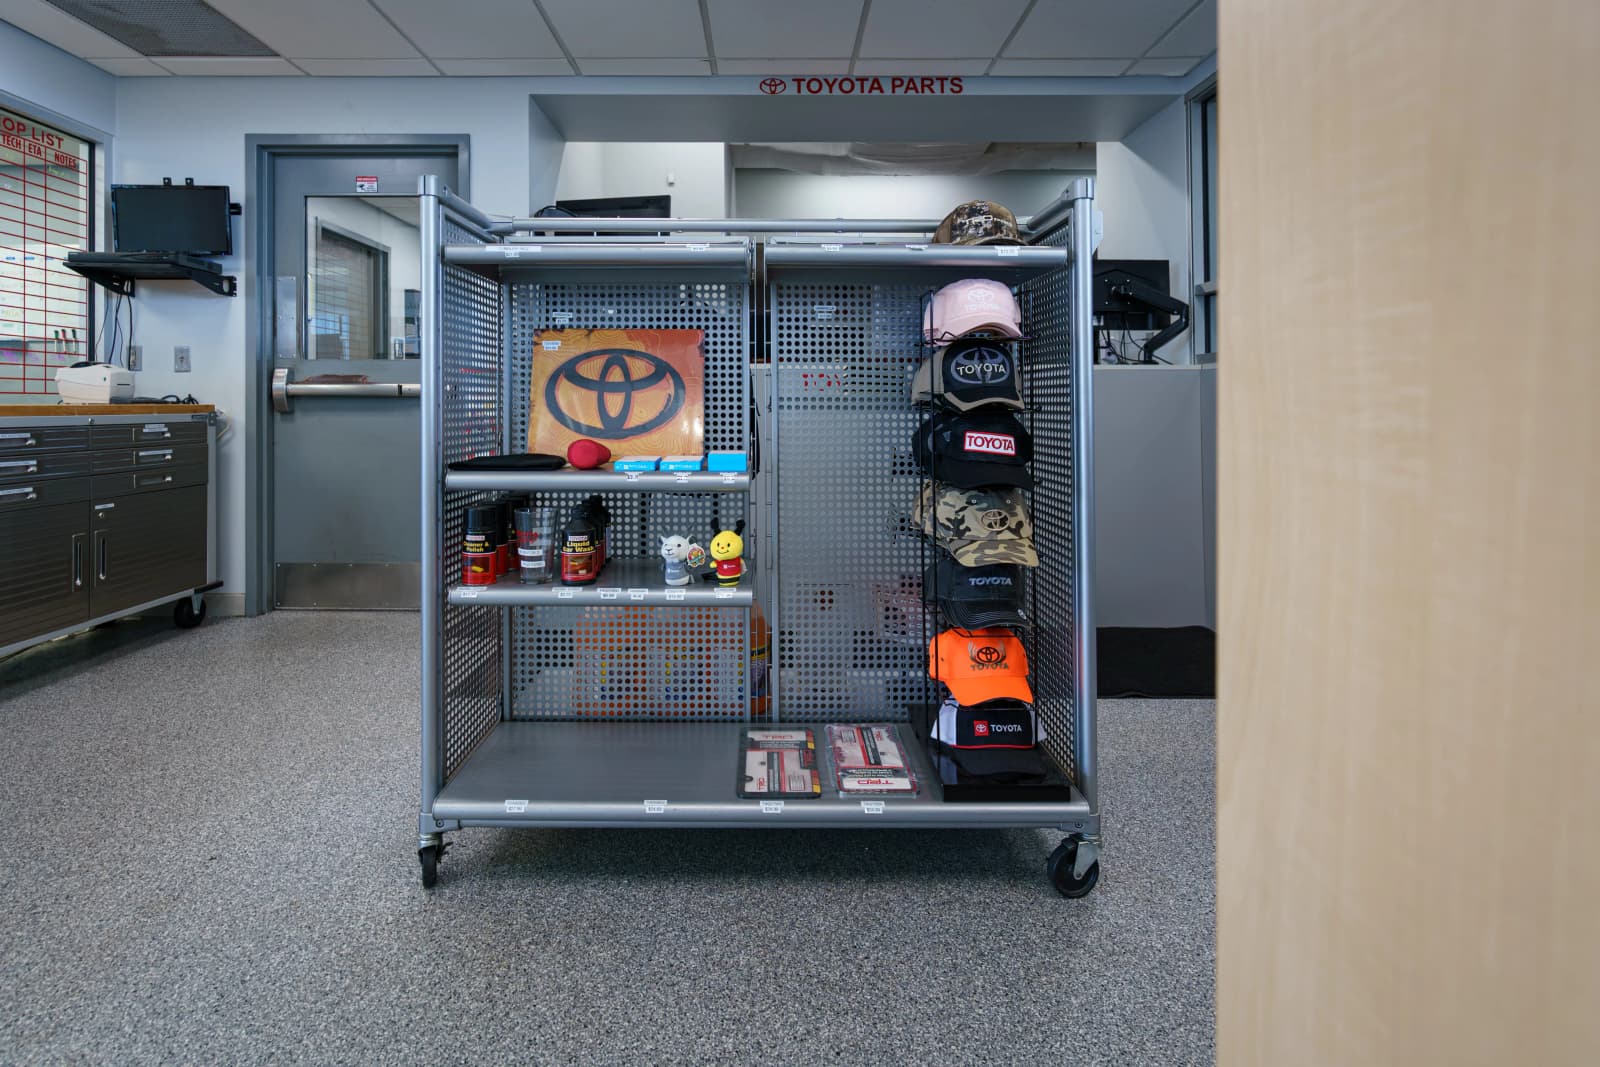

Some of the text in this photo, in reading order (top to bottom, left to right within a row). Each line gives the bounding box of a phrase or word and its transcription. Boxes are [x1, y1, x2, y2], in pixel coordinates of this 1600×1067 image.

[792, 77, 963, 94] TOYOTA PARTS
[2, 134, 21, 150] TECH
[32, 127, 64, 149] LIST
[28, 143, 42, 157] ETA
[54, 151, 77, 169] NOTES
[957, 363, 1006, 376] TOYOTA
[967, 435, 1014, 451] TOYOTA
[969, 577, 1013, 586] TOYOTA
[970, 662, 1009, 671] TOYOTA
[990, 724, 1022, 732] TOYOTA
